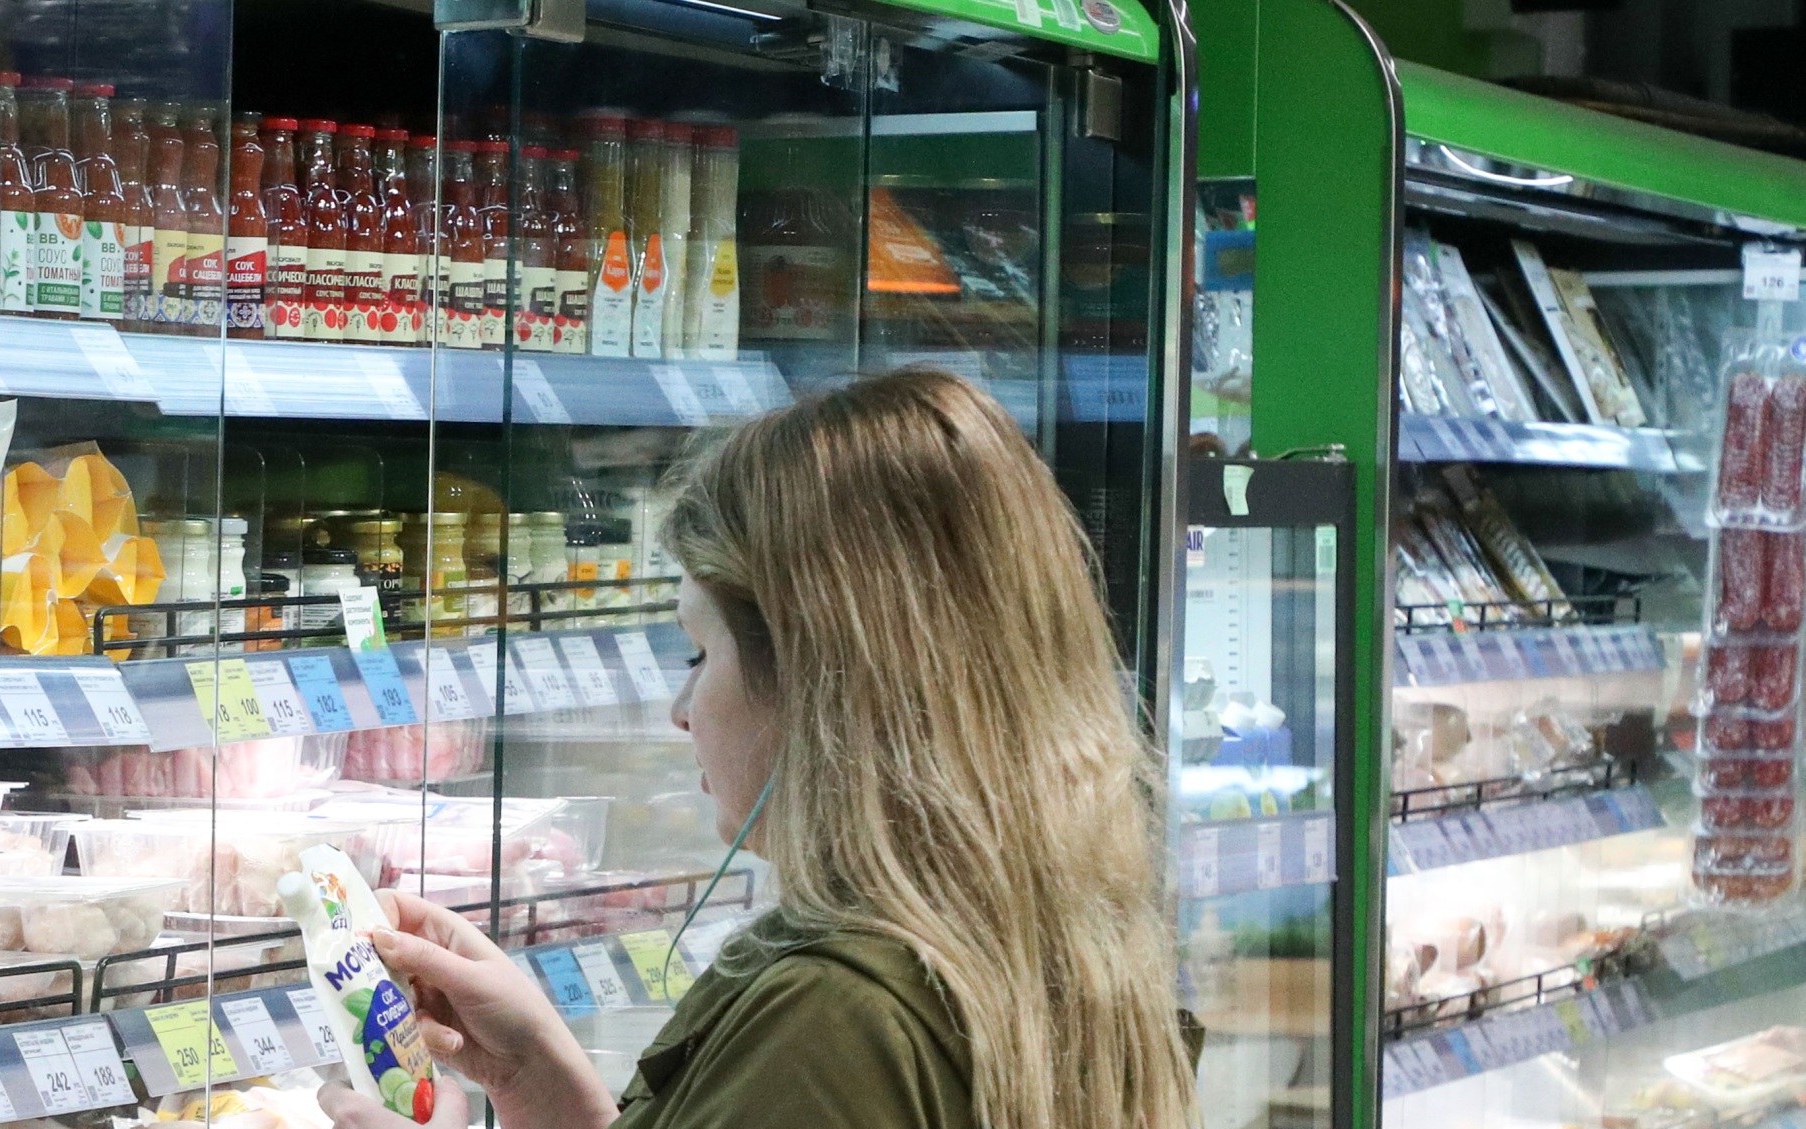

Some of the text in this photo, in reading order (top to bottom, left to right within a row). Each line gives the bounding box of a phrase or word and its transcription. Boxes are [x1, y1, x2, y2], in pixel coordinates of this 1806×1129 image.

[38, 248, 67, 264] СОУС
[235, 261, 255, 271] СОУС
[316, 694, 339, 714] 182
[381, 688, 403, 708] 193
[438, 683, 459, 704] 105
[23, 707, 50, 729] 115
[108, 705, 134, 726] 118
[240, 697, 260, 718] 100
[272, 699, 295, 720] 115
[253, 1035, 277, 1057] 344
[176, 1046, 201, 1069] 250
[46, 1071, 72, 1093] 242
[93, 1065, 116, 1088] 188
